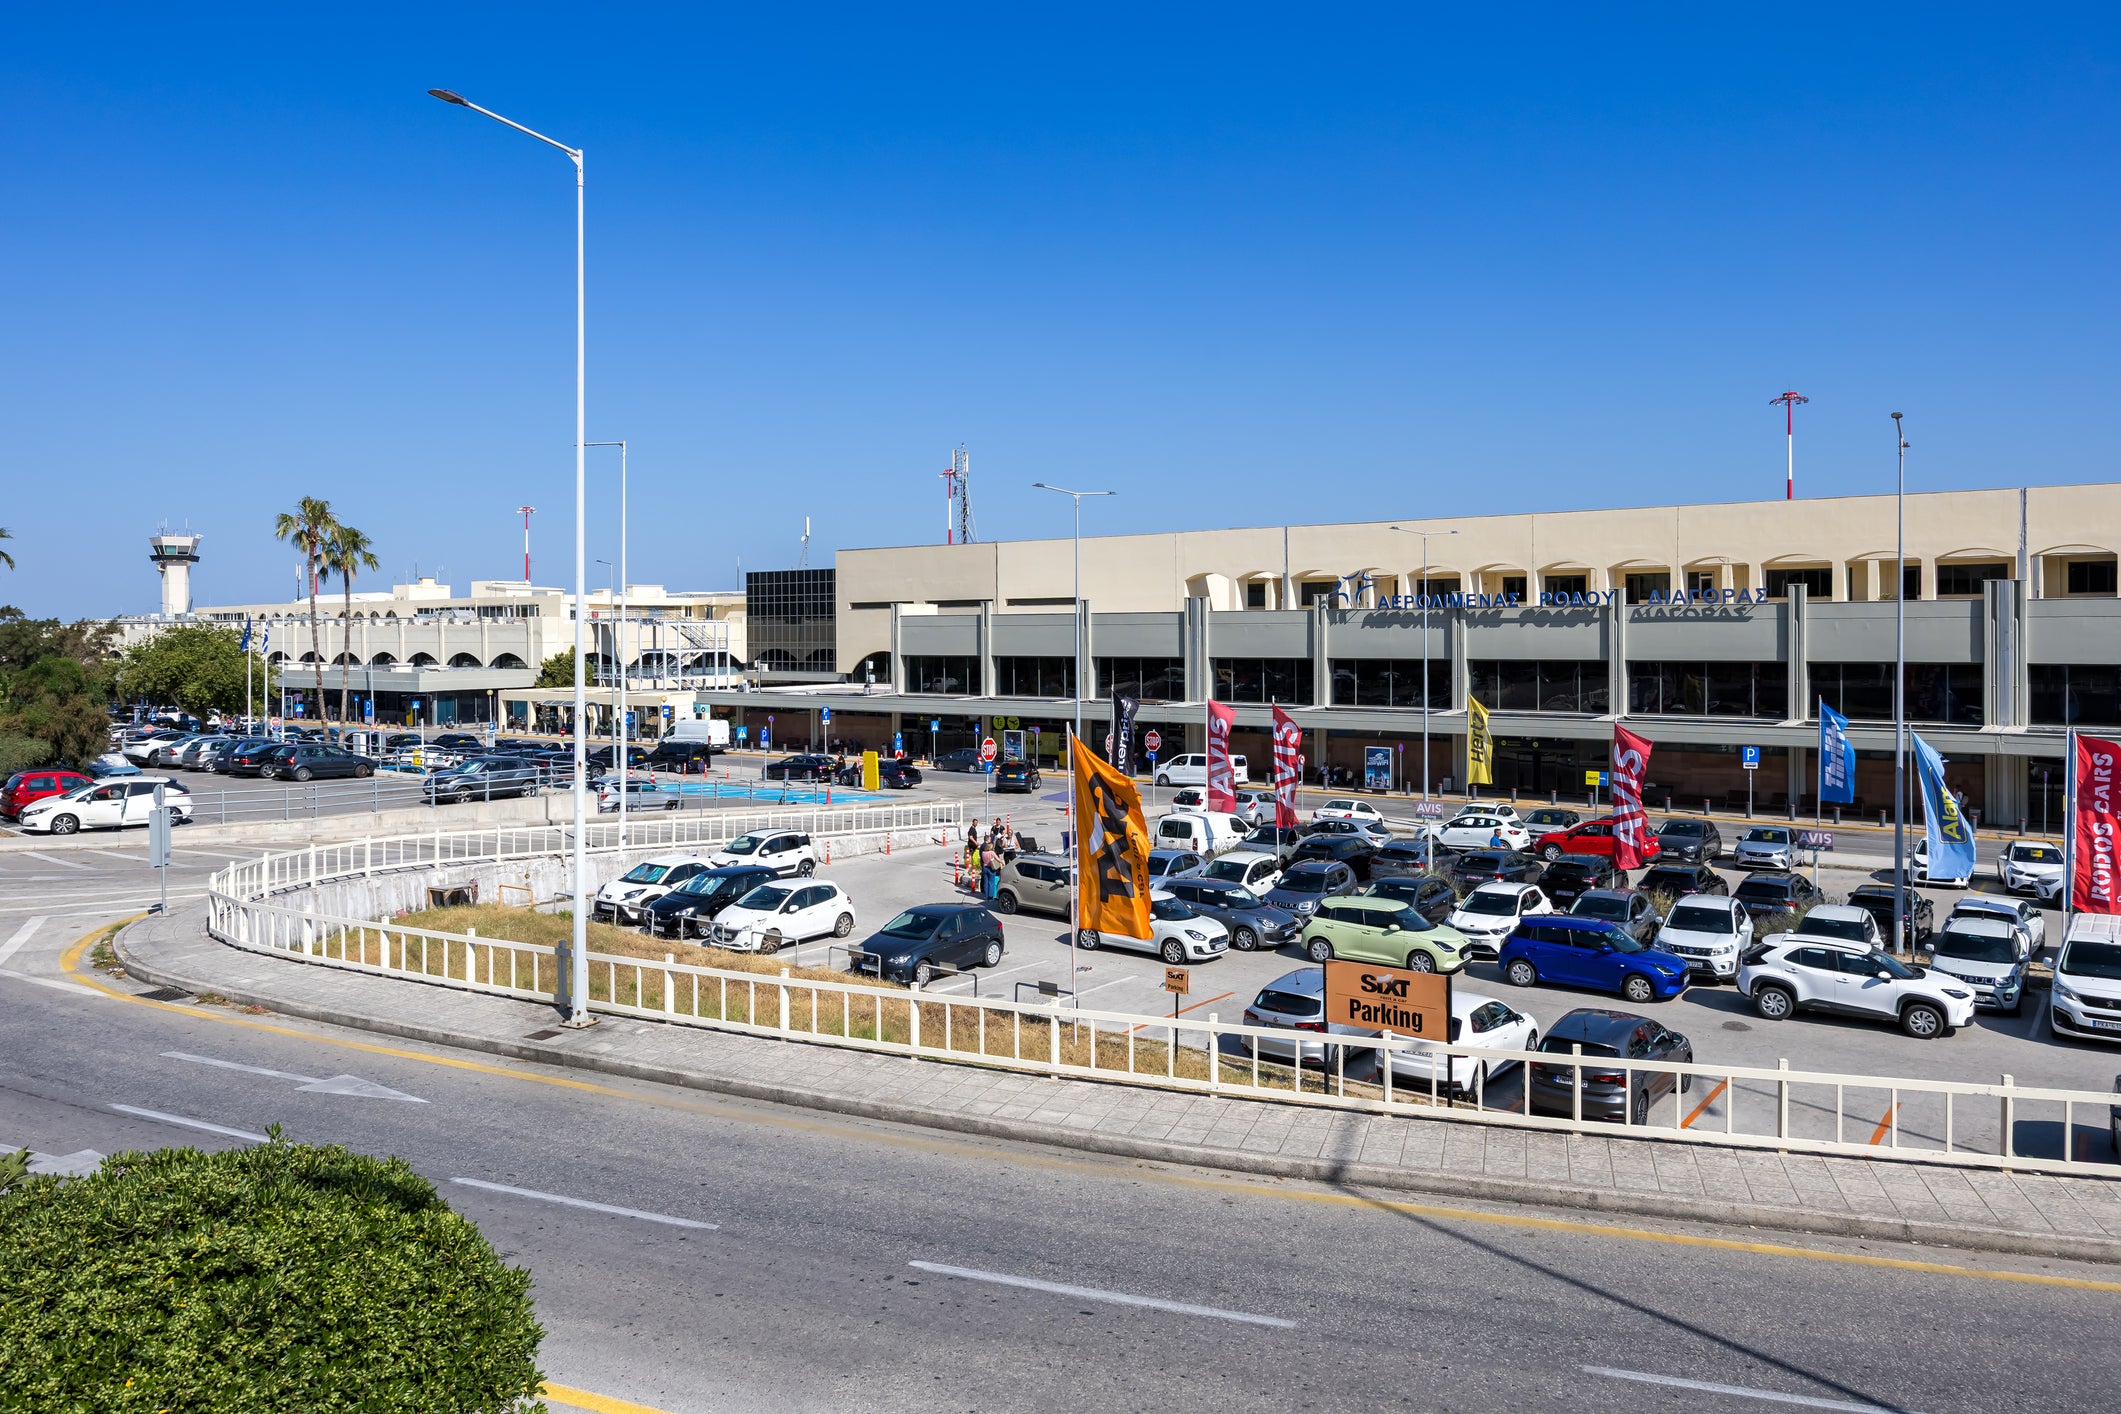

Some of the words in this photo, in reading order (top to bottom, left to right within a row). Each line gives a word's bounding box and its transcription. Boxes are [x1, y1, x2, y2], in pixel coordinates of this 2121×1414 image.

[1377, 592, 1520, 609] ΑΕΡΟΛΙΜΕΝΑΣ
[1539, 590, 1616, 607] ΡΟΔΟΥ
[1647, 587, 1769, 605] ΔΙΑΓΟΡΑΣ
[983, 744, 996, 756] STOP
[1146, 736, 1160, 747] STOP
[1471, 711, 1485, 763] Hertz
[1747, 748, 1755, 760] P
[1210, 714, 1234, 797] AVIS
[1273, 718, 1299, 811] AVIS
[1613, 742, 1643, 848] AVIS
[2092, 752, 2114, 814] CARS
[1416, 803, 1442, 813] AVIS
[1798, 831, 1832, 844] AVIS
[2091, 821, 2114, 902] RODOS
[1349, 998, 1423, 1033] Parking
